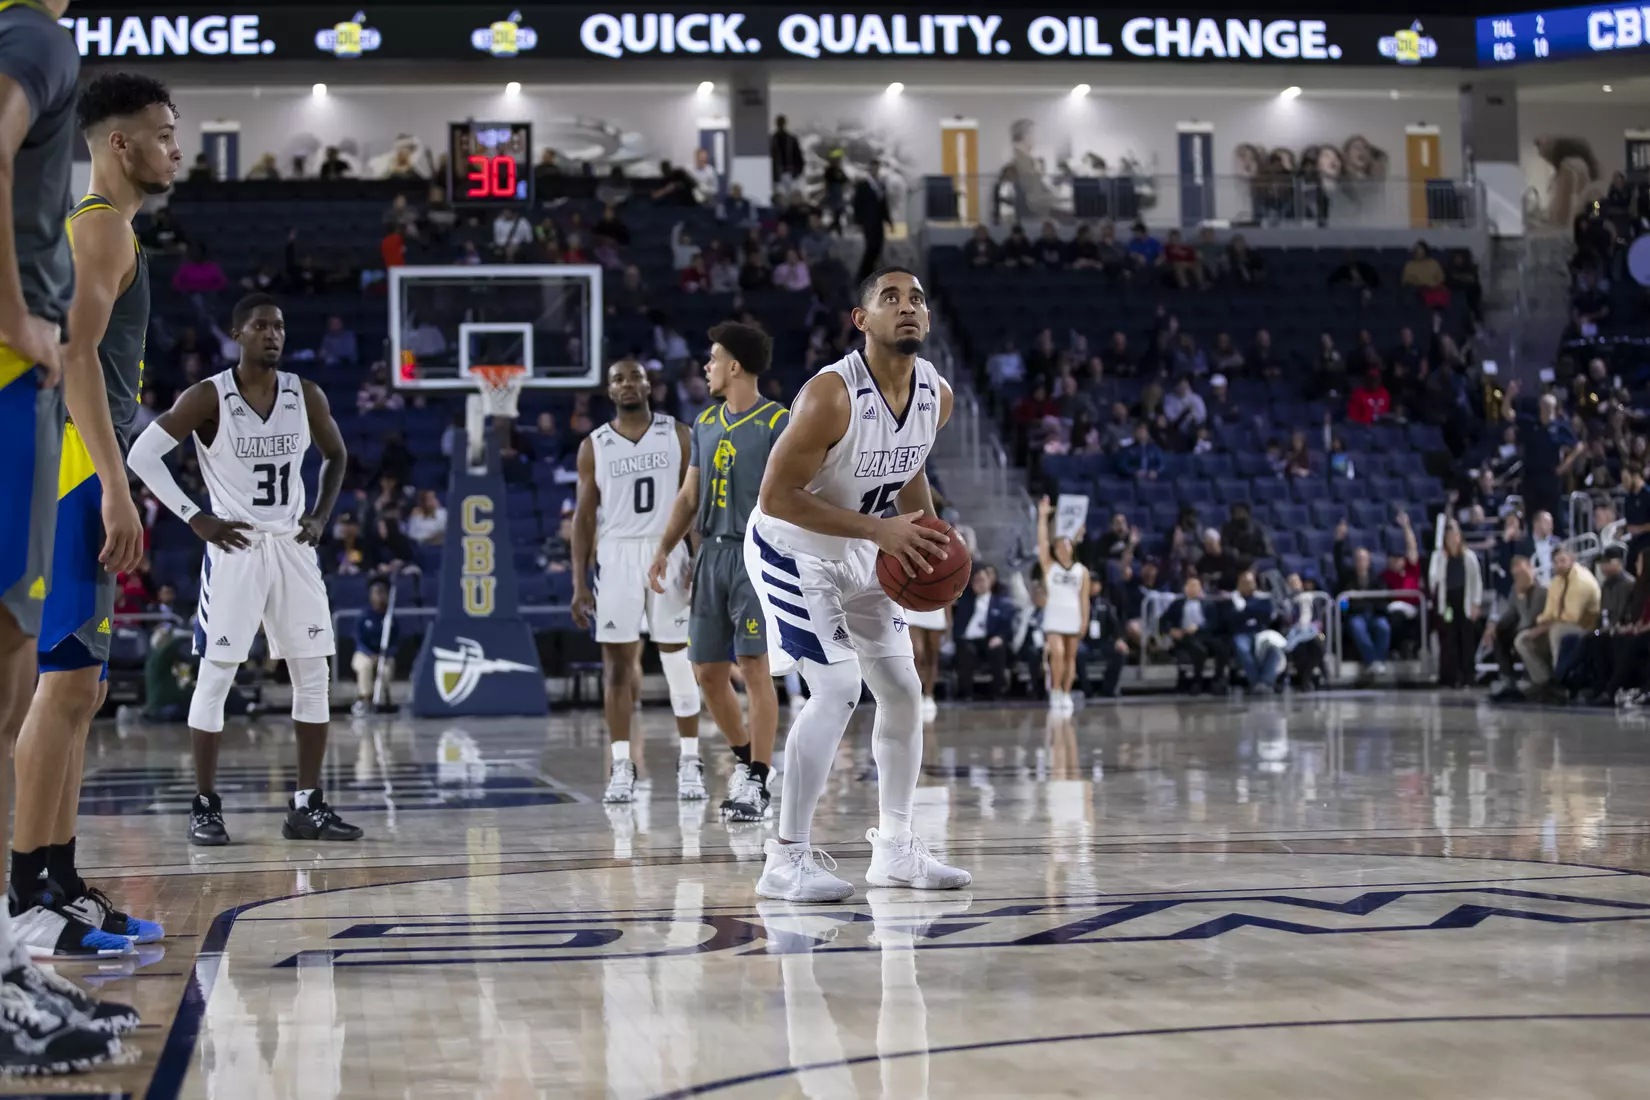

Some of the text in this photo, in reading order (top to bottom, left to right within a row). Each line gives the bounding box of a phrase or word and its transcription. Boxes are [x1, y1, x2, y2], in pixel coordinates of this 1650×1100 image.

[56, 16, 276, 56] HANGE.
[580, 13, 1343, 60] QUICK. QUALITY. OIL CHANGE.
[467, 155, 516, 197] 30
[236, 433, 300, 458] LANCERS
[609, 452, 670, 478] LANCERS
[252, 461, 291, 506] 31
[634, 476, 655, 514] 0
[460, 495, 497, 617] CBU
